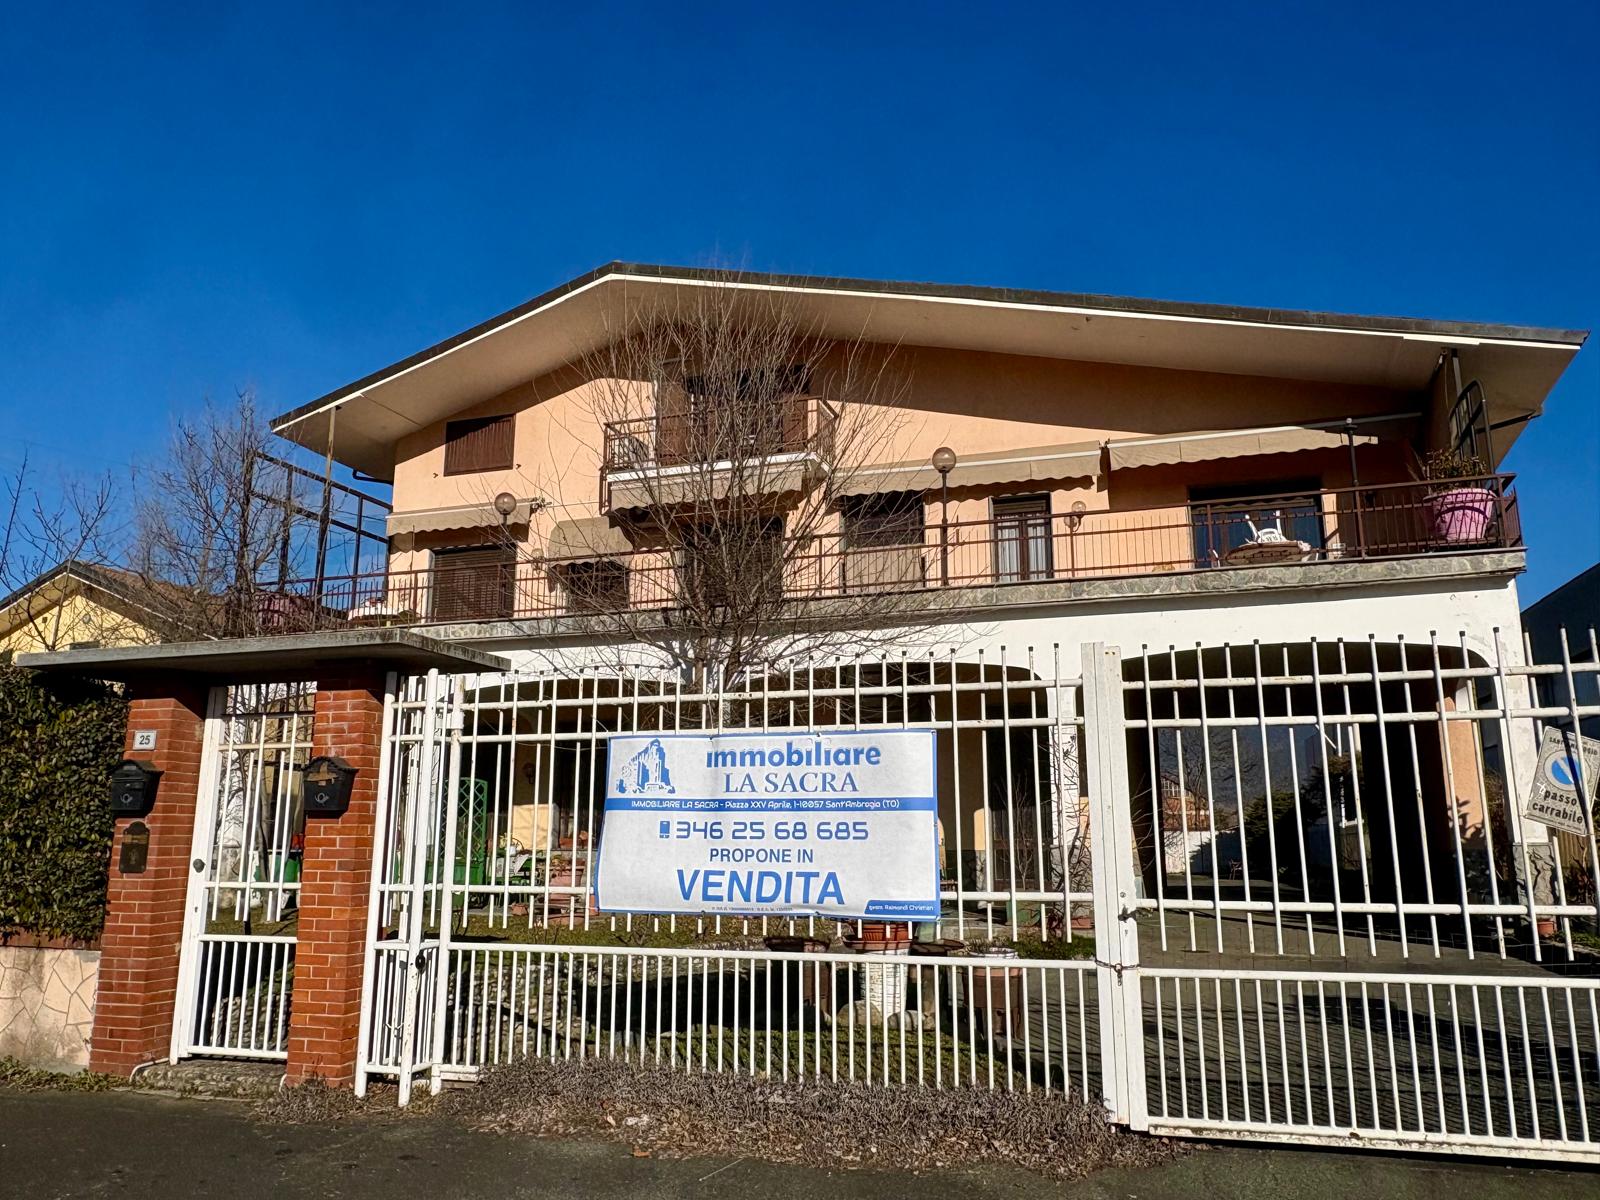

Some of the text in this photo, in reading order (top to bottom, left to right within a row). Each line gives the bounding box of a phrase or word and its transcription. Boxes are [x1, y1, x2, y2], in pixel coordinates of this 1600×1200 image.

[139, 734, 151, 746] 25
[706, 741, 881, 768] immobiliare
[724, 772, 860, 793] LA SACRA
[631, 800, 681, 808] IMMOBILIARE
[682, 800, 693, 809] LA
[694, 801, 719, 810] SACRA
[725, 801, 749, 810] Piazza
[750, 800, 768, 809] XXV
[882, 799, 900, 809] (TO)
[1543, 789, 1578, 807] passo
[1532, 802, 1583, 824] carrabile
[676, 821, 869, 840] 346 25 68 685
[709, 848, 814, 863] PROPONE IN
[676, 869, 846, 905] VENDITA
